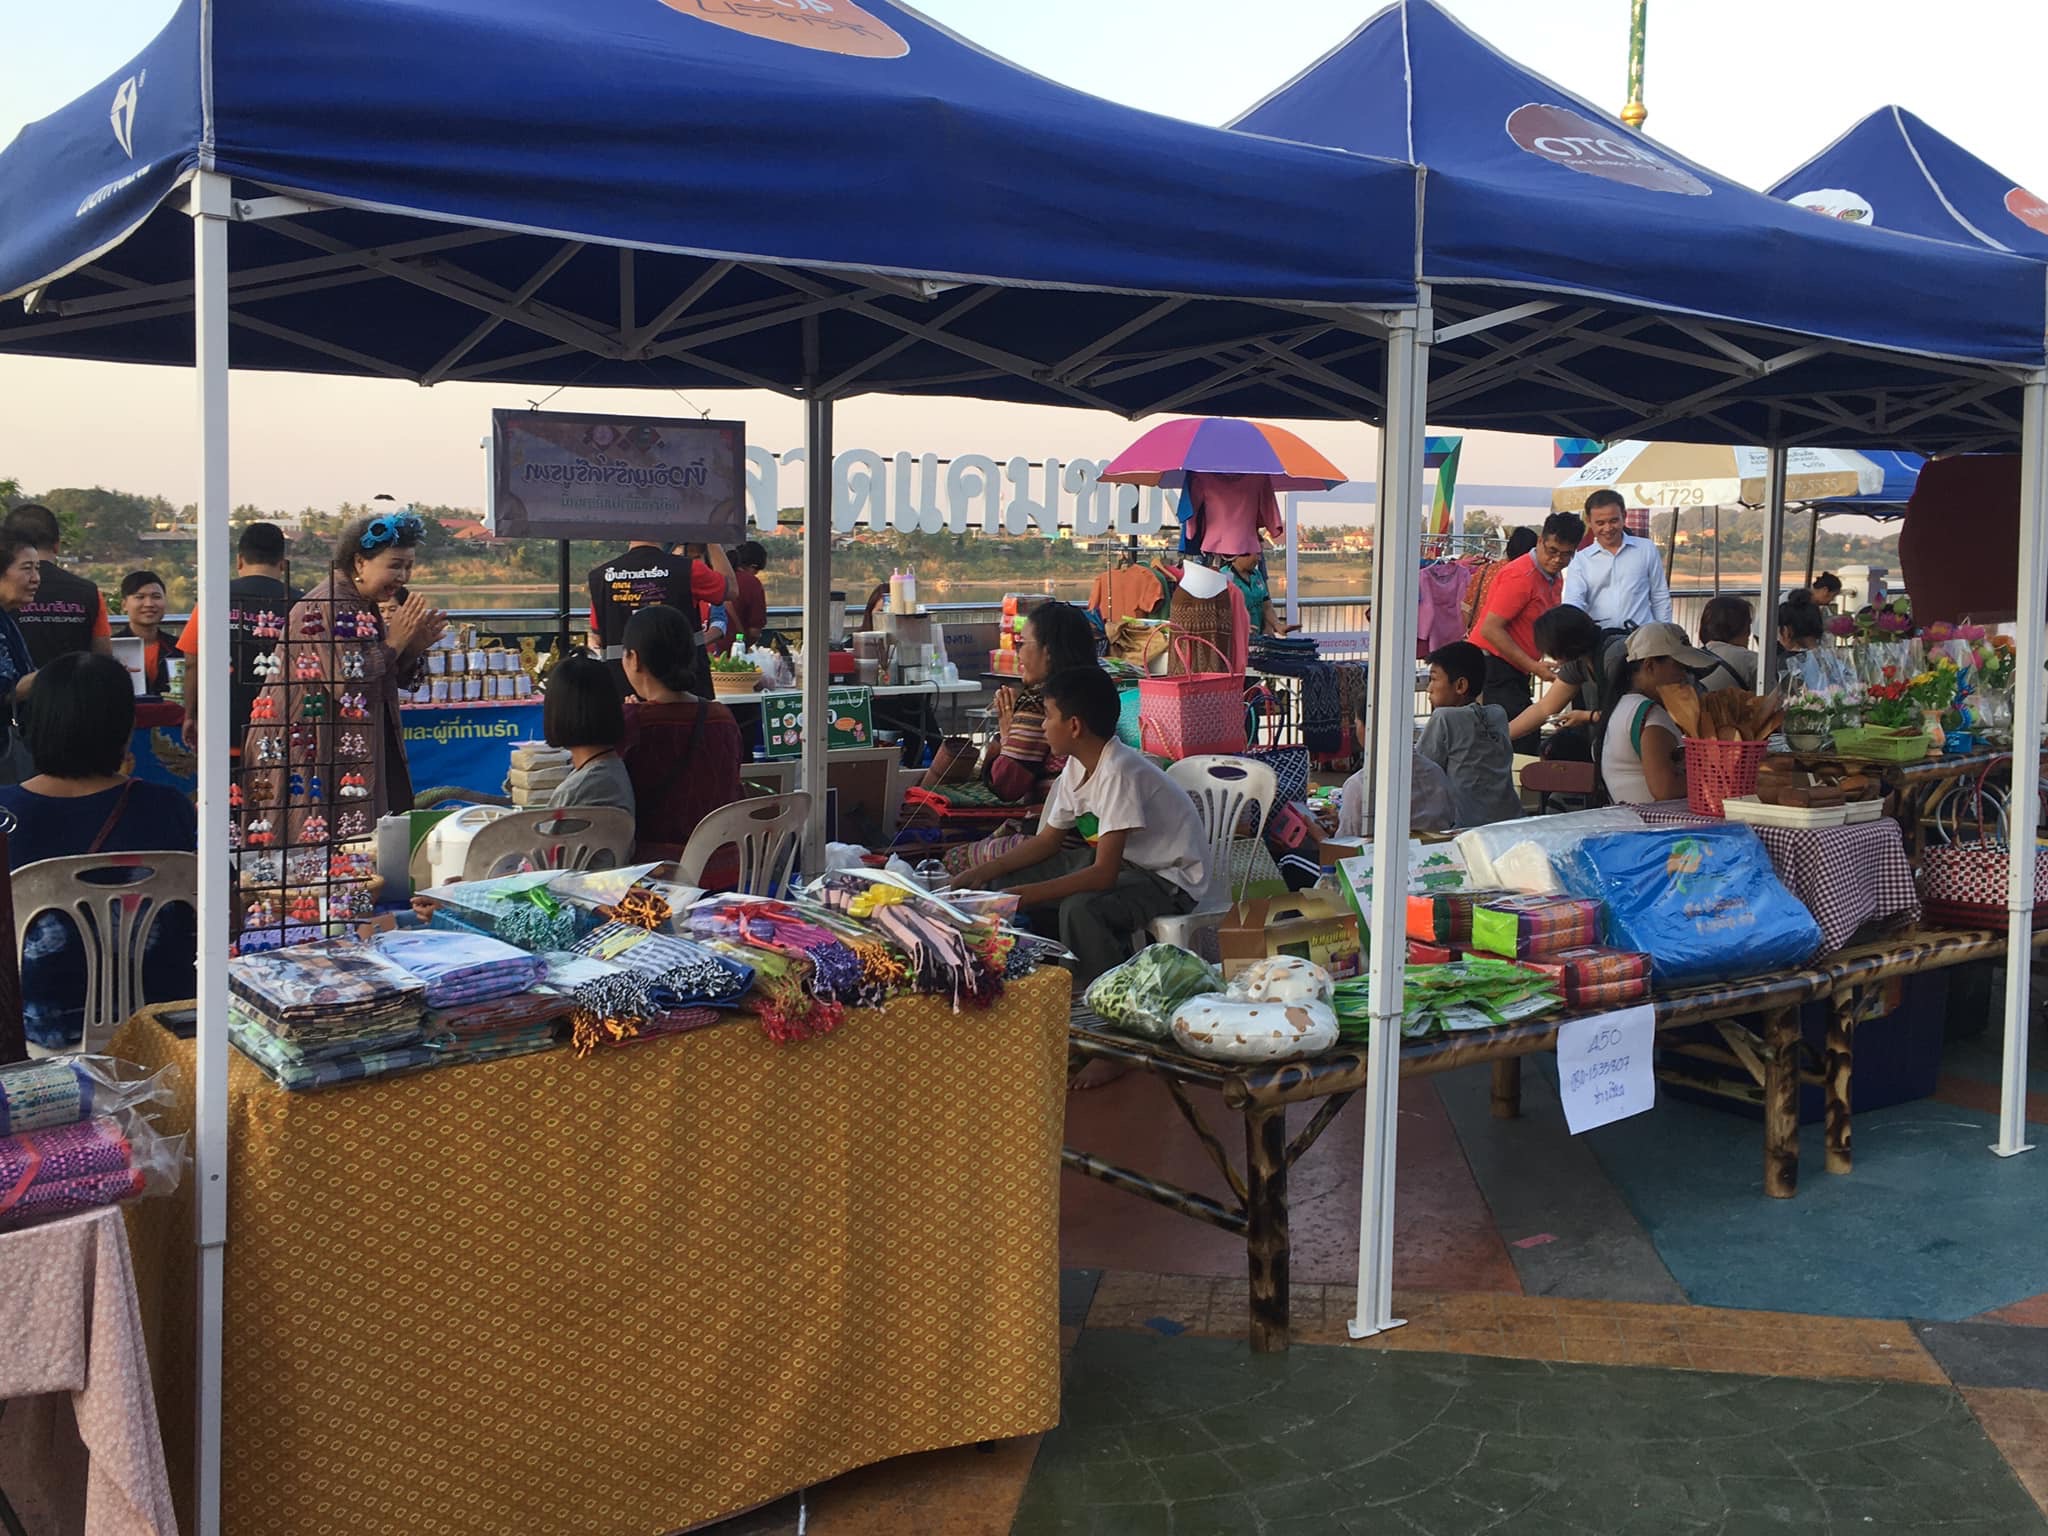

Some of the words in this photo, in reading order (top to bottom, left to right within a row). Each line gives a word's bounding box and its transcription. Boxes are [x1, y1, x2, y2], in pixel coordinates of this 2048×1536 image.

[1656, 488, 1704, 505] 1729
[403, 716, 519, 745] และผู้ที่ท่านรัก
